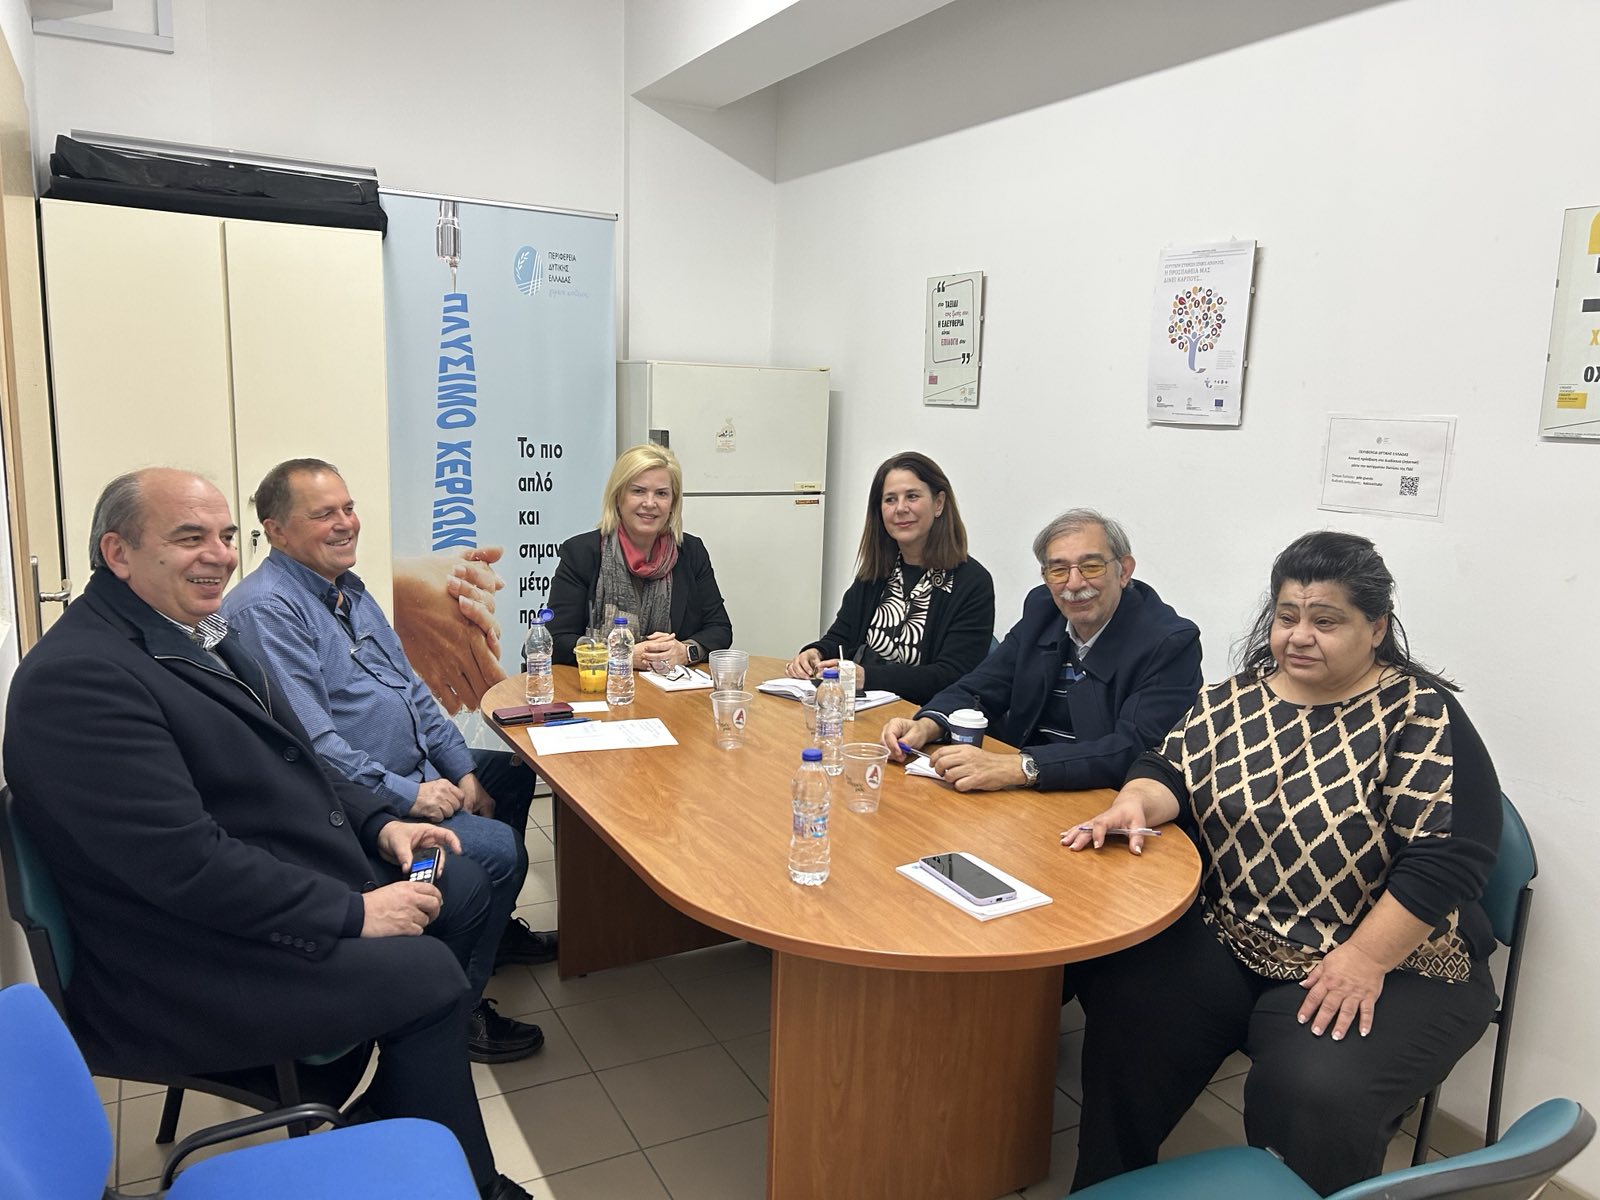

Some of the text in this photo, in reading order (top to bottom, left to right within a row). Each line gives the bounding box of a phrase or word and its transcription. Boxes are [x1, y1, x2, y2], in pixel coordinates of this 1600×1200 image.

[548, 251, 577, 262] ΠΕΡΙΦΕΡΕΙΑ
[548, 264, 569, 272] ΔΥΤΙΚΗΣ
[548, 274, 571, 284] ΕΛΛΑΔΑΣ
[942, 319, 964, 328] ΕΛΕΥΘΕΡΙΑ
[432, 293, 477, 551] ΠΛΥΣΙΜΟ ΧΕΡΙΩΝ
[517, 436, 563, 458] Το πιο
[518, 471, 553, 492] απλό
[519, 510, 540, 525] και
[519, 543, 562, 564] σημαν
[519, 571, 550, 597] μέτρ
